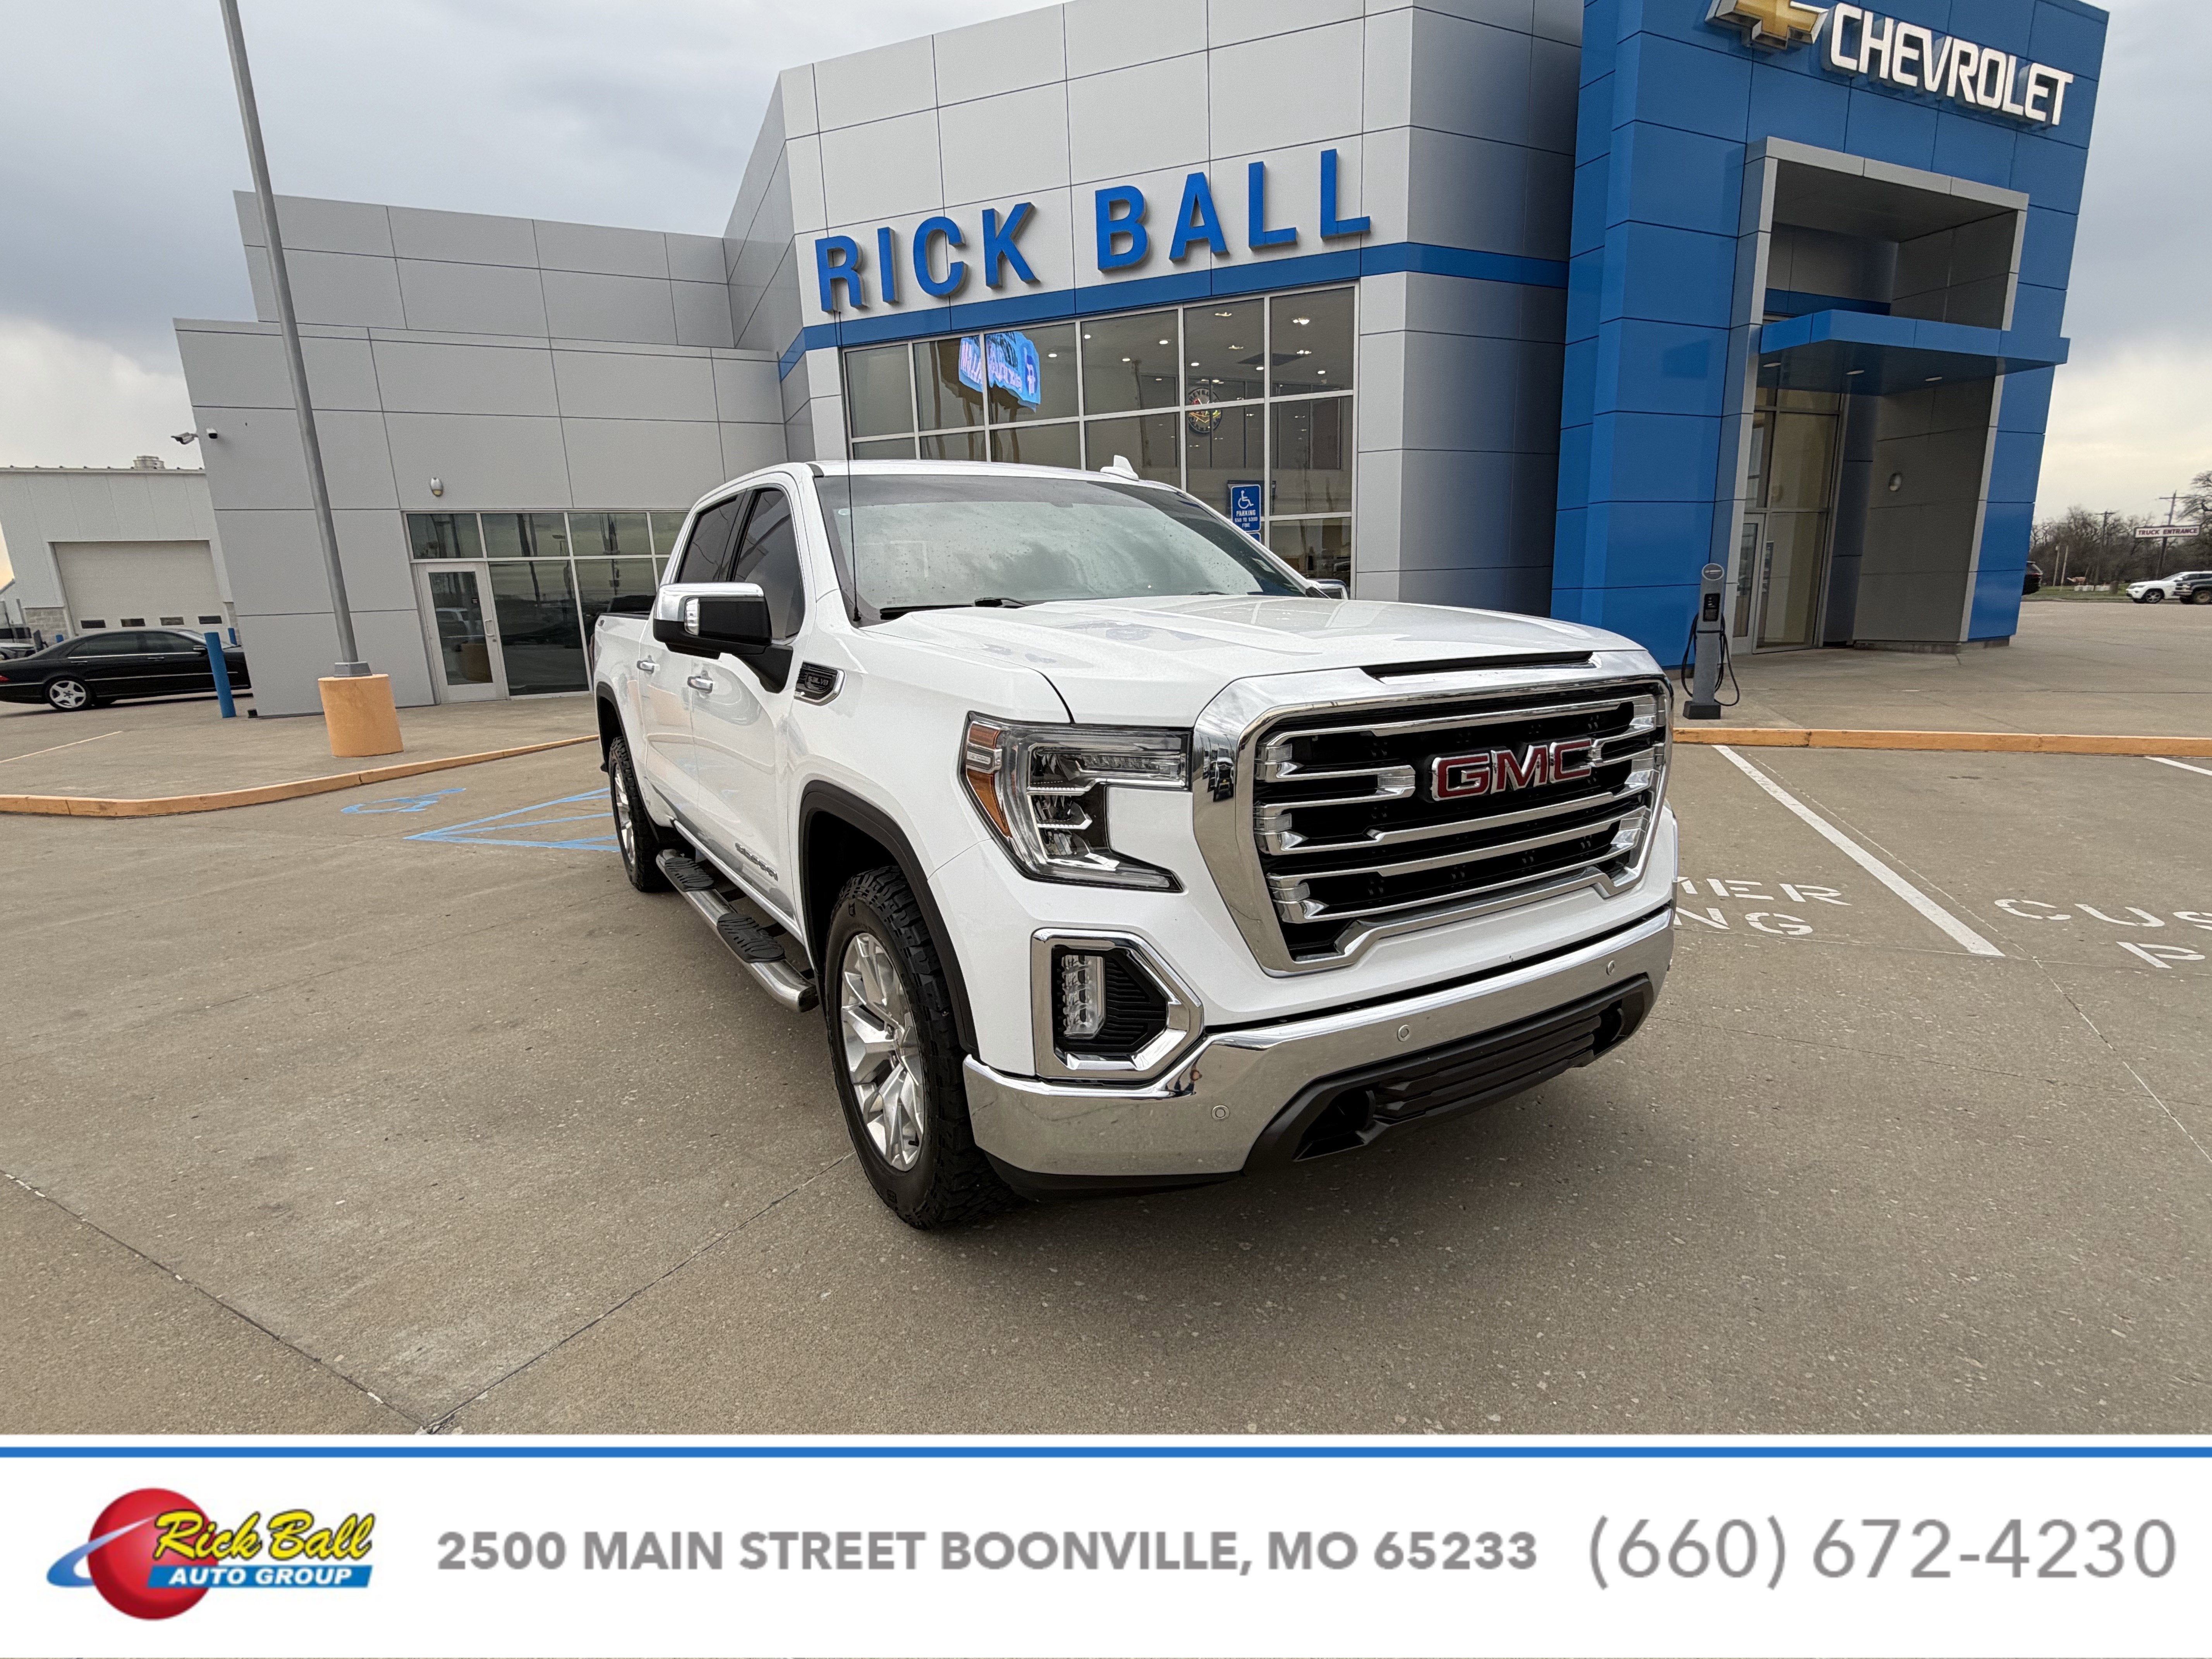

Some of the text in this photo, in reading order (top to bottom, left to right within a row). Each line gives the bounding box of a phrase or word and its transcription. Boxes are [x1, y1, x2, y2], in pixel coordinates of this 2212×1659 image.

[1830, 2, 2074, 125] CHEVROLET
[815, 148, 1371, 312] RICK BALL
[1432, 738, 1592, 801] GMC
[2116, 941, 2205, 969] P
